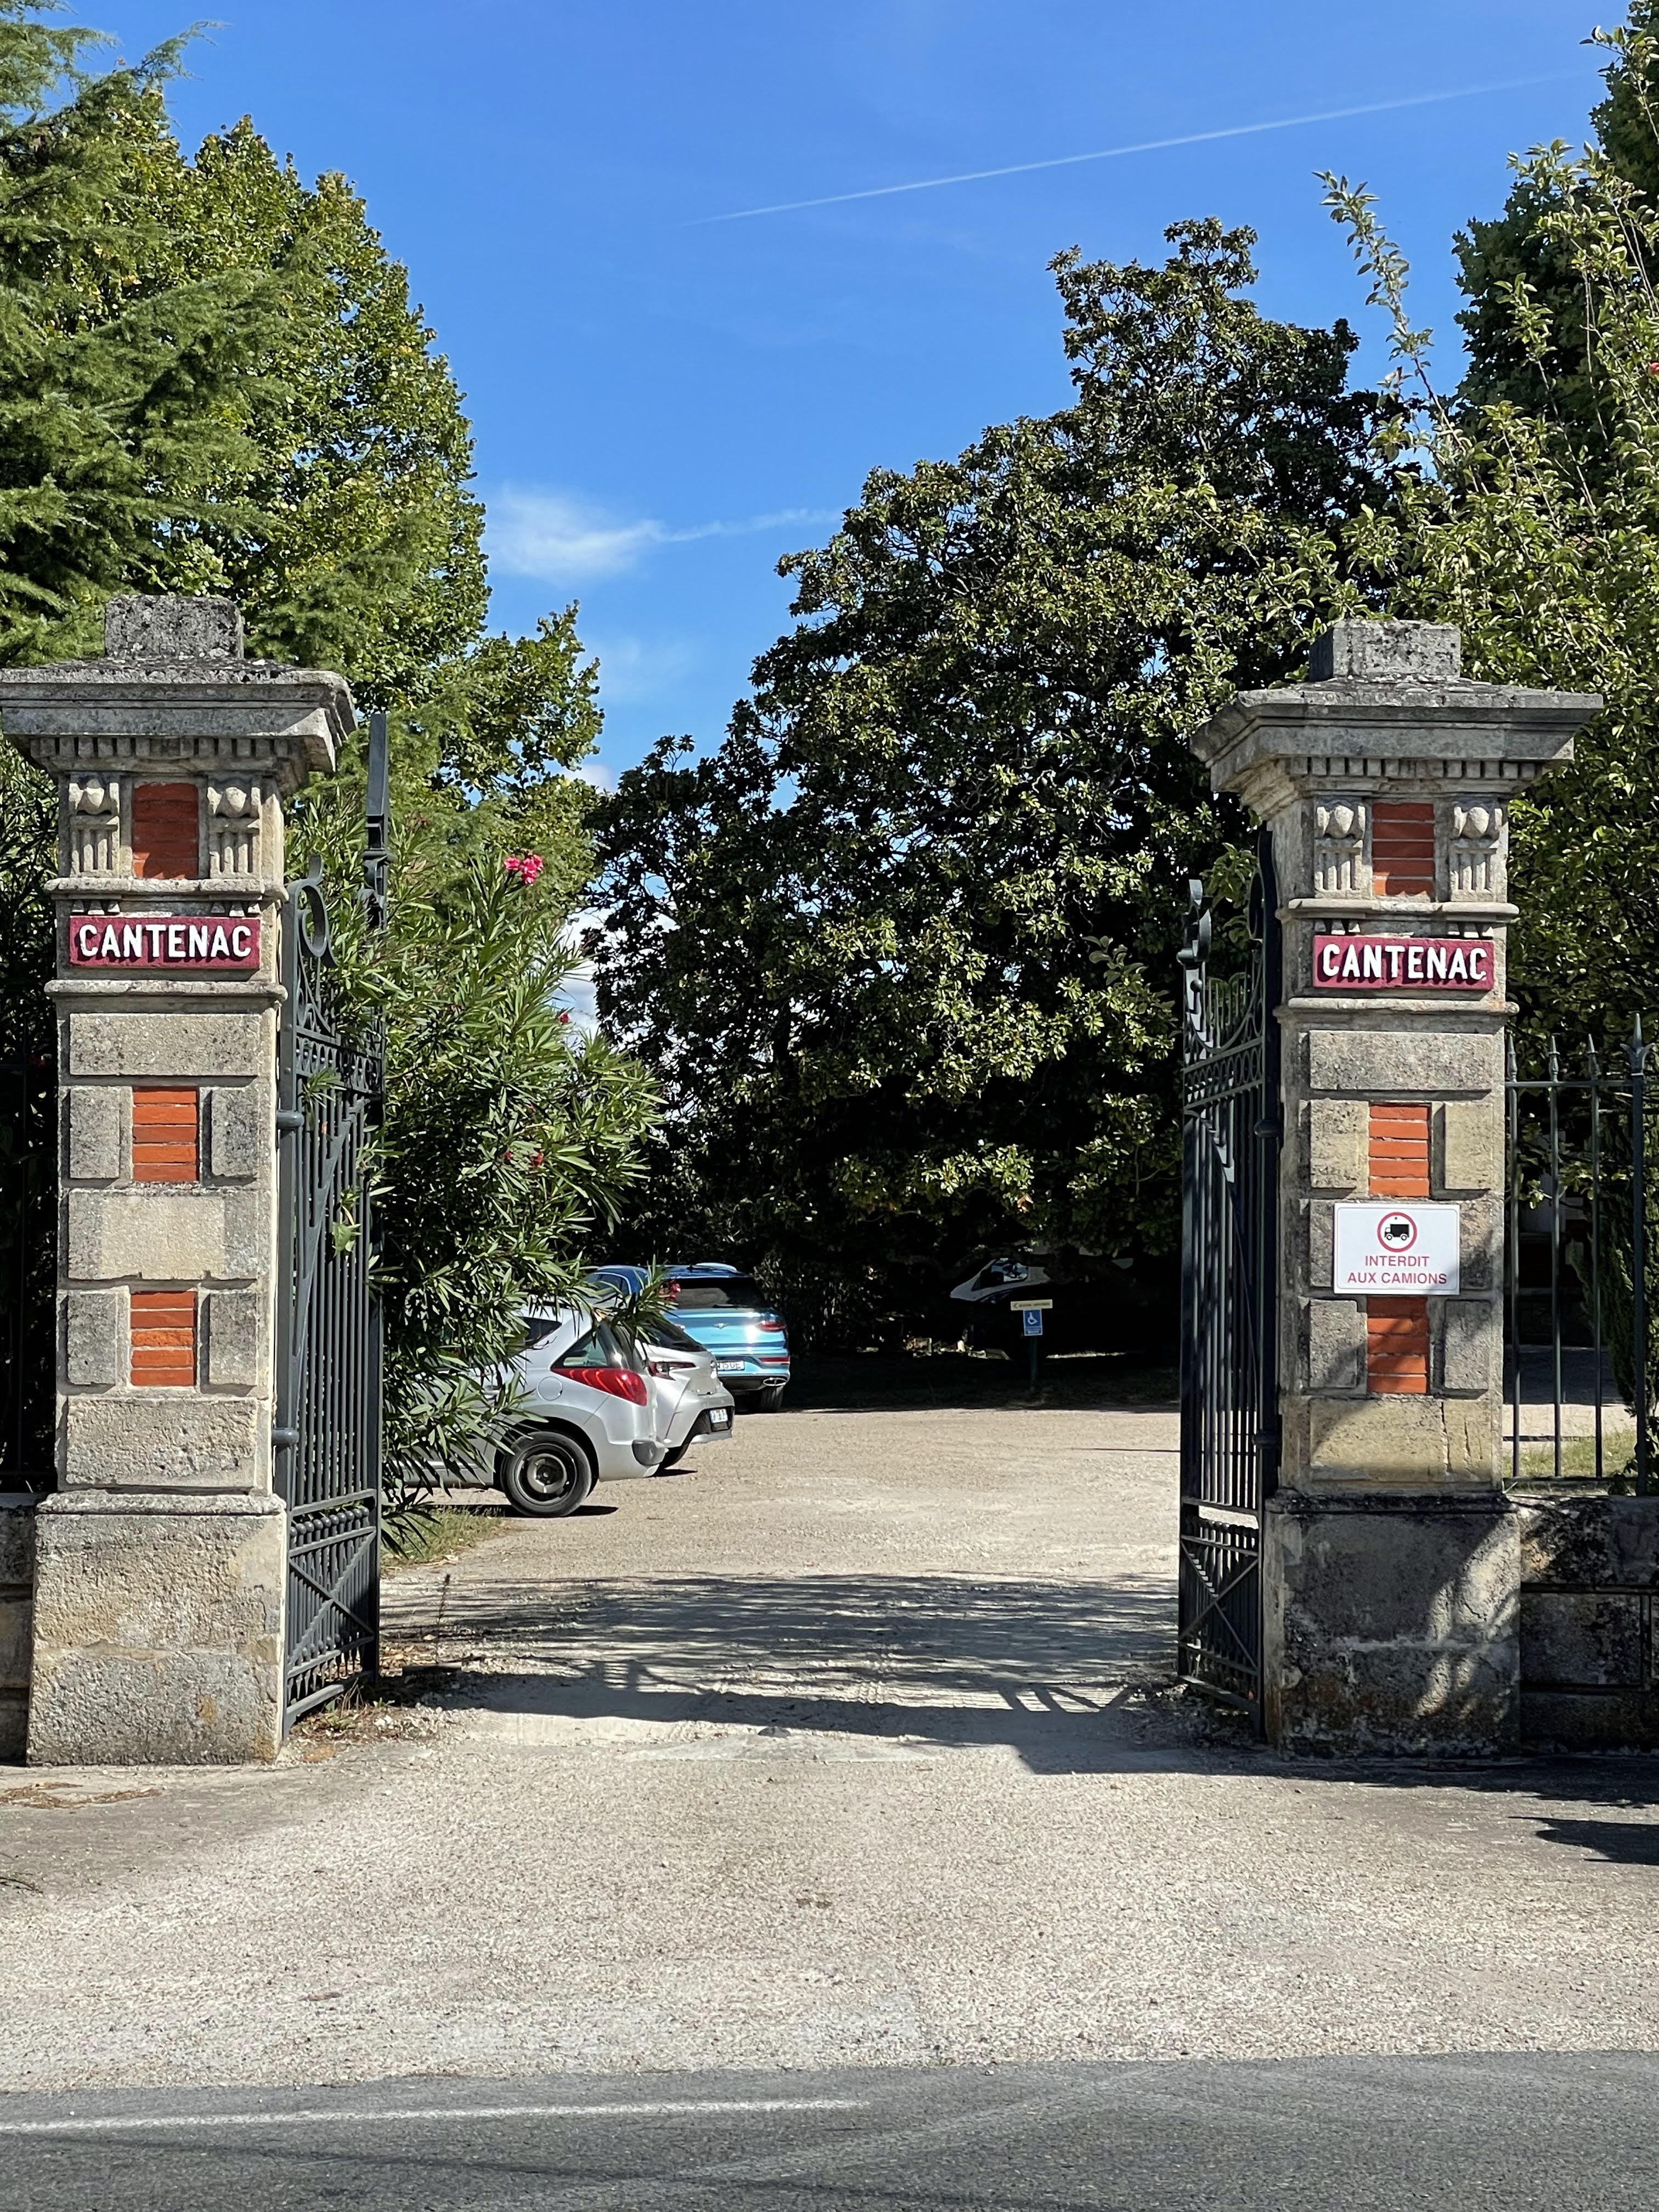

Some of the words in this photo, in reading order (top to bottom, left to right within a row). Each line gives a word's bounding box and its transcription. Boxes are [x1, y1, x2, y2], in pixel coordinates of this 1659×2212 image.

[78, 924, 251, 958] CANTENAC
[1322, 943, 1487, 981] CANTENAC
[1364, 1255, 1430, 1267] INTERDIT
[1347, 1272, 1376, 1284] AUX
[1380, 1272, 1447, 1284] CAMIONS
